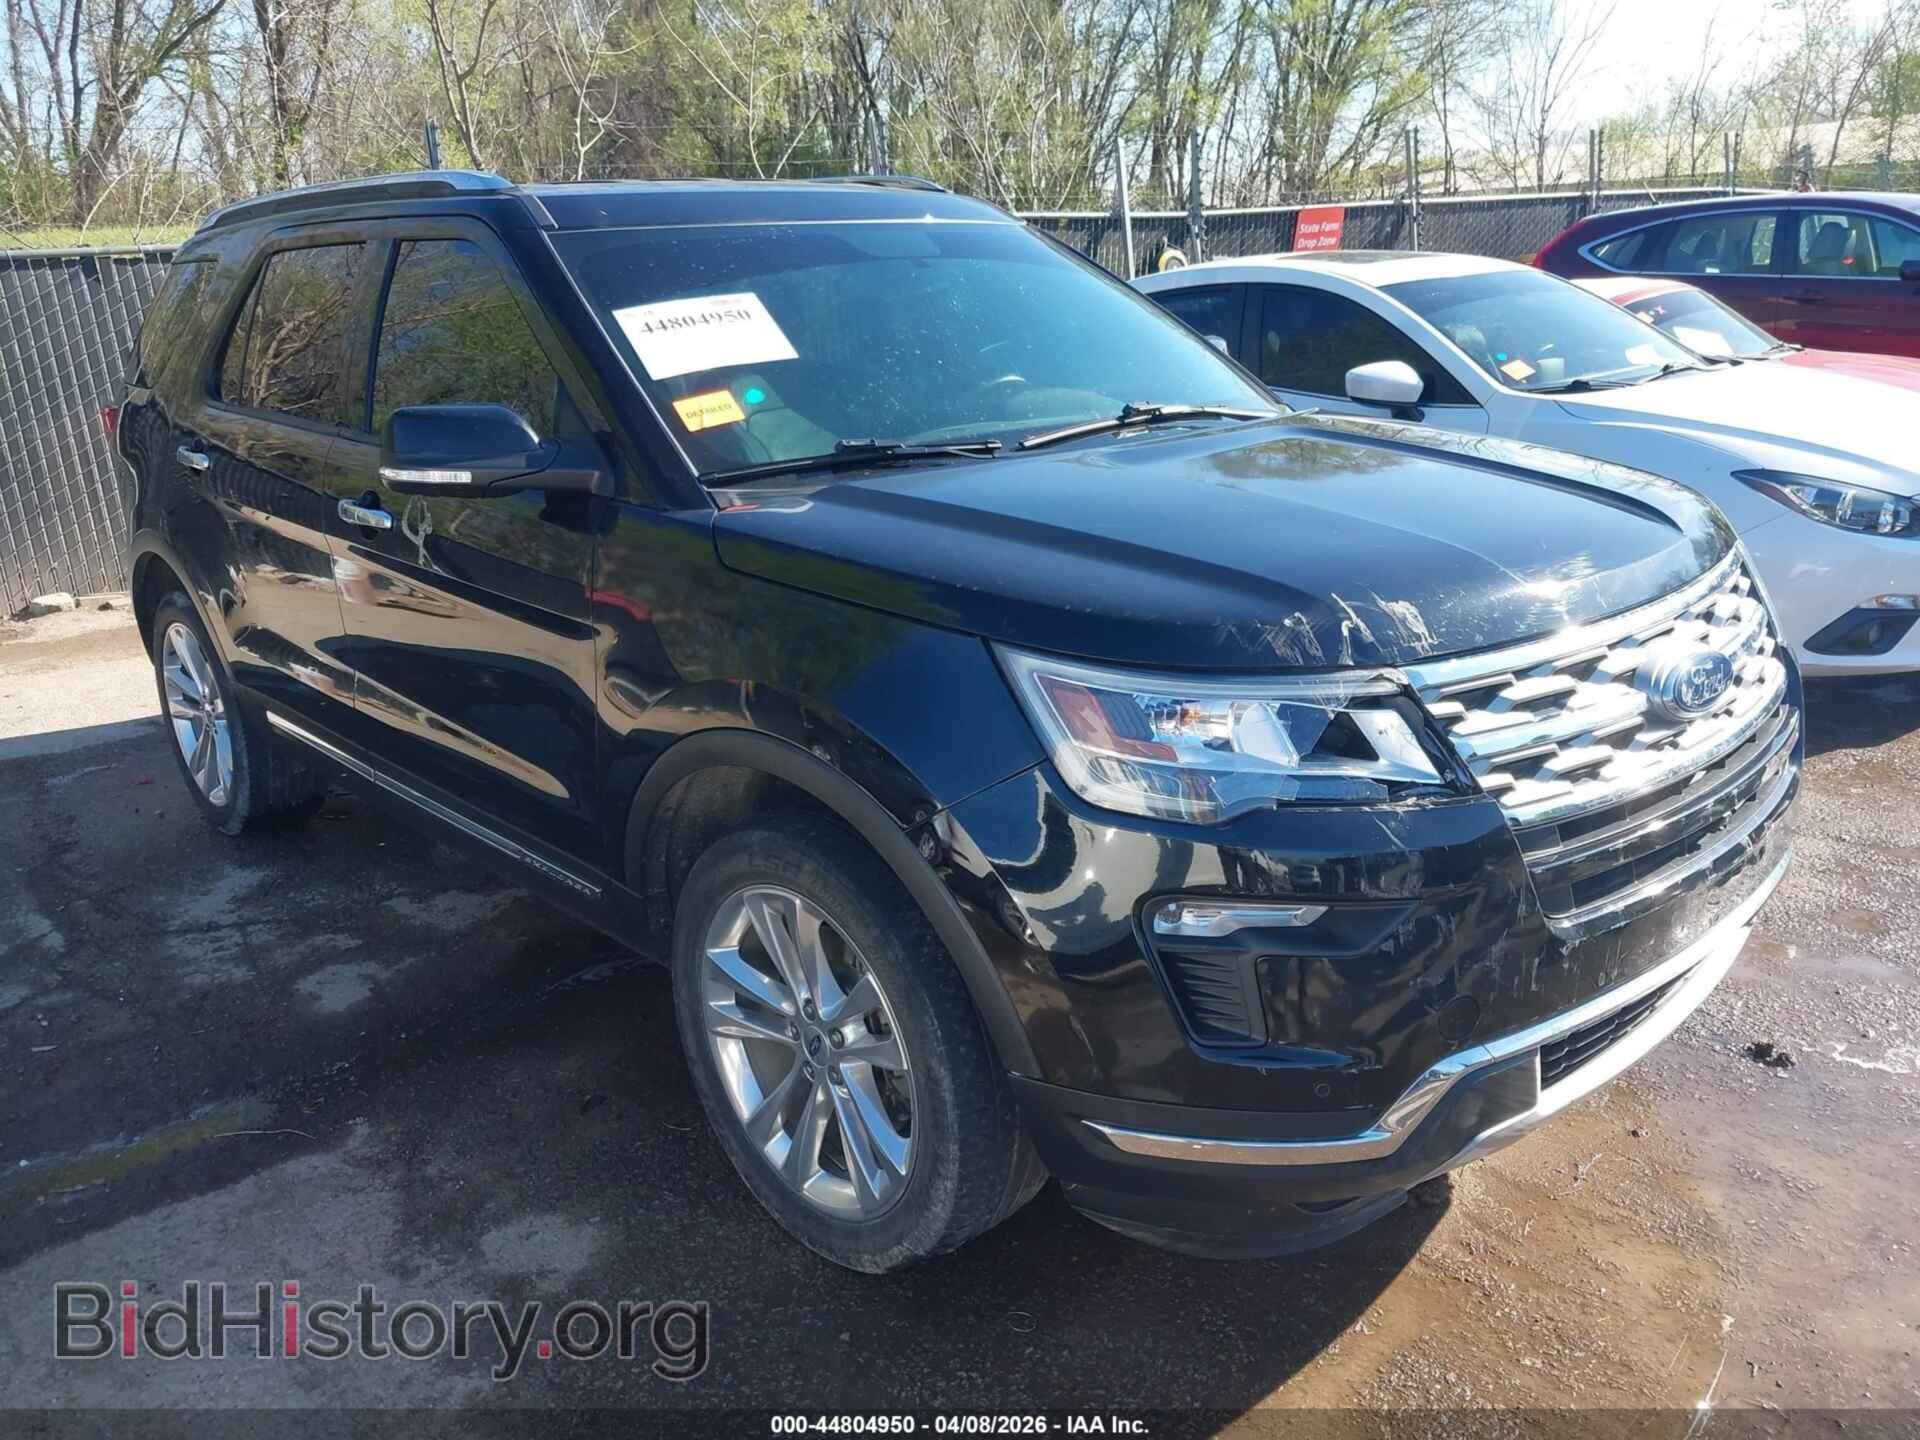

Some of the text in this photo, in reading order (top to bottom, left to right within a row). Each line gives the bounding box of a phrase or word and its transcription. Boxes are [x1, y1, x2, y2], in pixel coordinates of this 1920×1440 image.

[1299, 222, 1340, 234] State Farm
[1297, 236, 1337, 248] Drop Zone
[641, 309, 752, 335] 44804950
[685, 402, 732, 418] DETAILED
[1681, 660, 1731, 706] Ford
